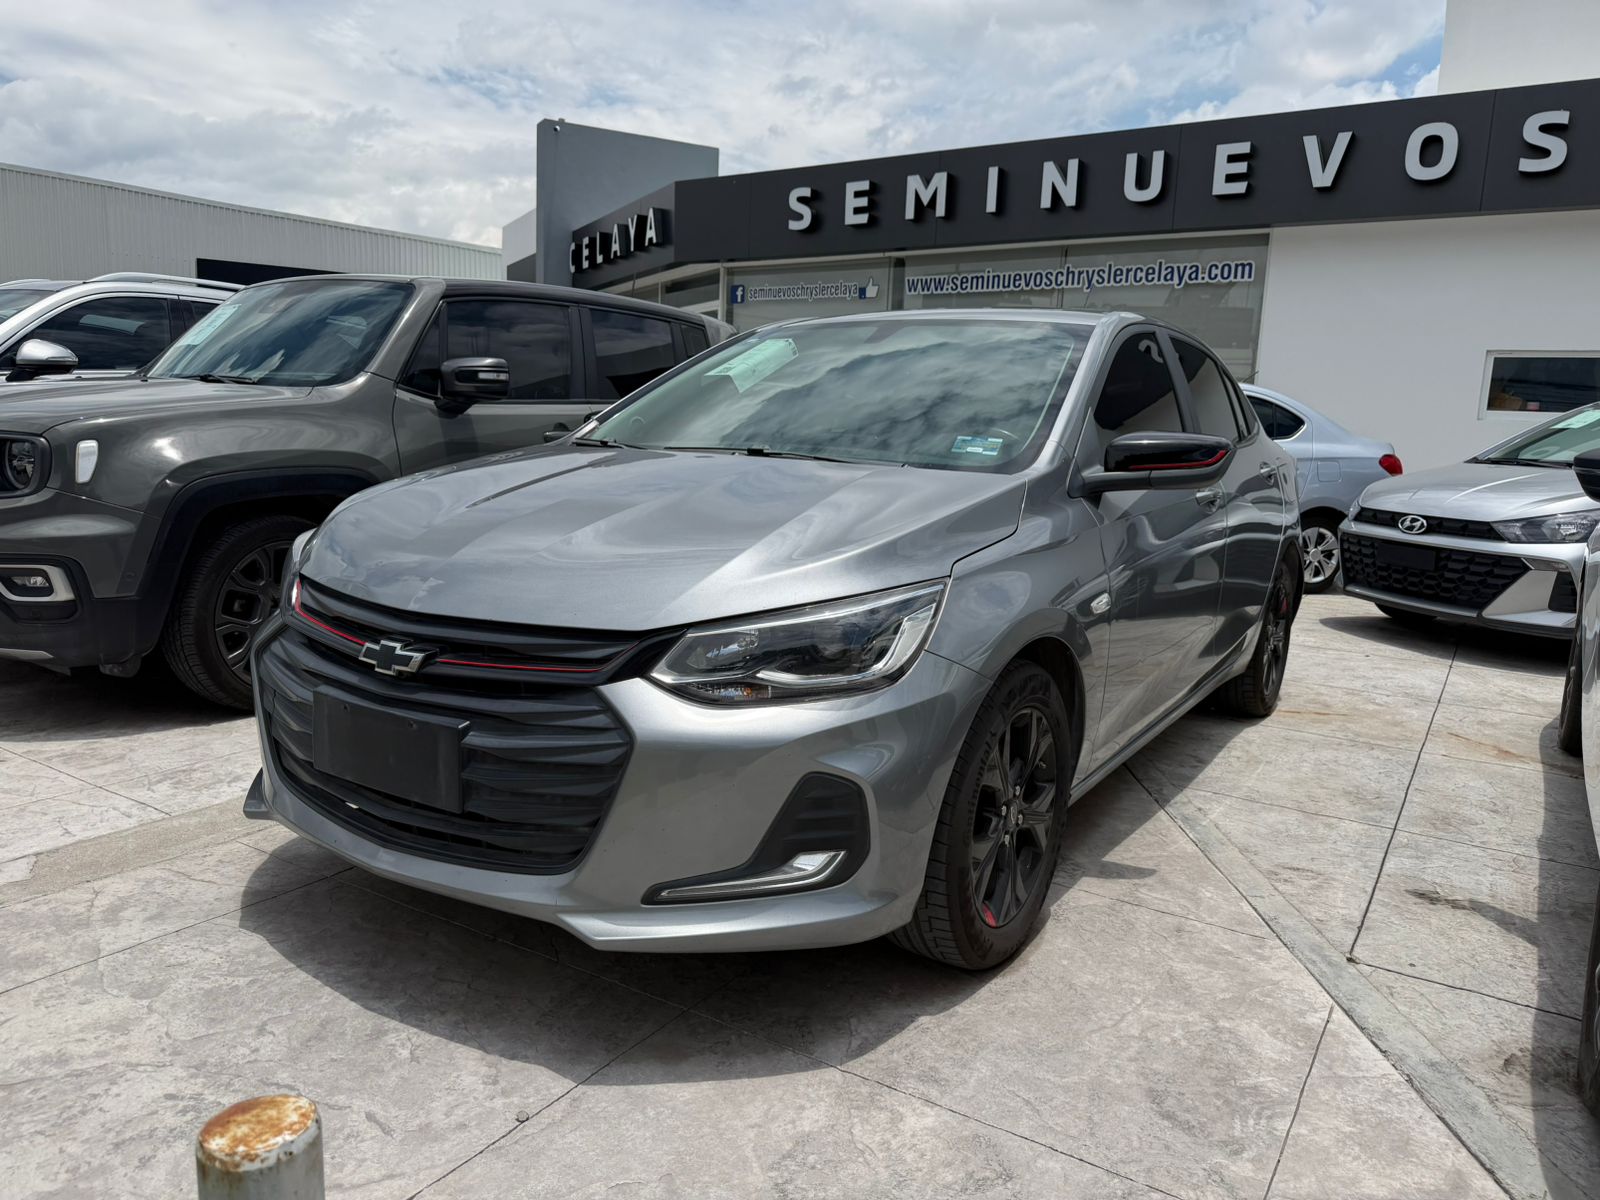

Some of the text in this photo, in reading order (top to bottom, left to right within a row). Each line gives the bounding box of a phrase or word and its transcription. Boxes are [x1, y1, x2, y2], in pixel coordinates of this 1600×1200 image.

[787, 109, 1571, 231] SEMINUEVOS
[569, 207, 657, 273] CELAYA
[749, 281, 858, 301] seminuevoschryslercelaya
[905, 259, 1255, 292] www.seminuevoschryslercelaya.com
